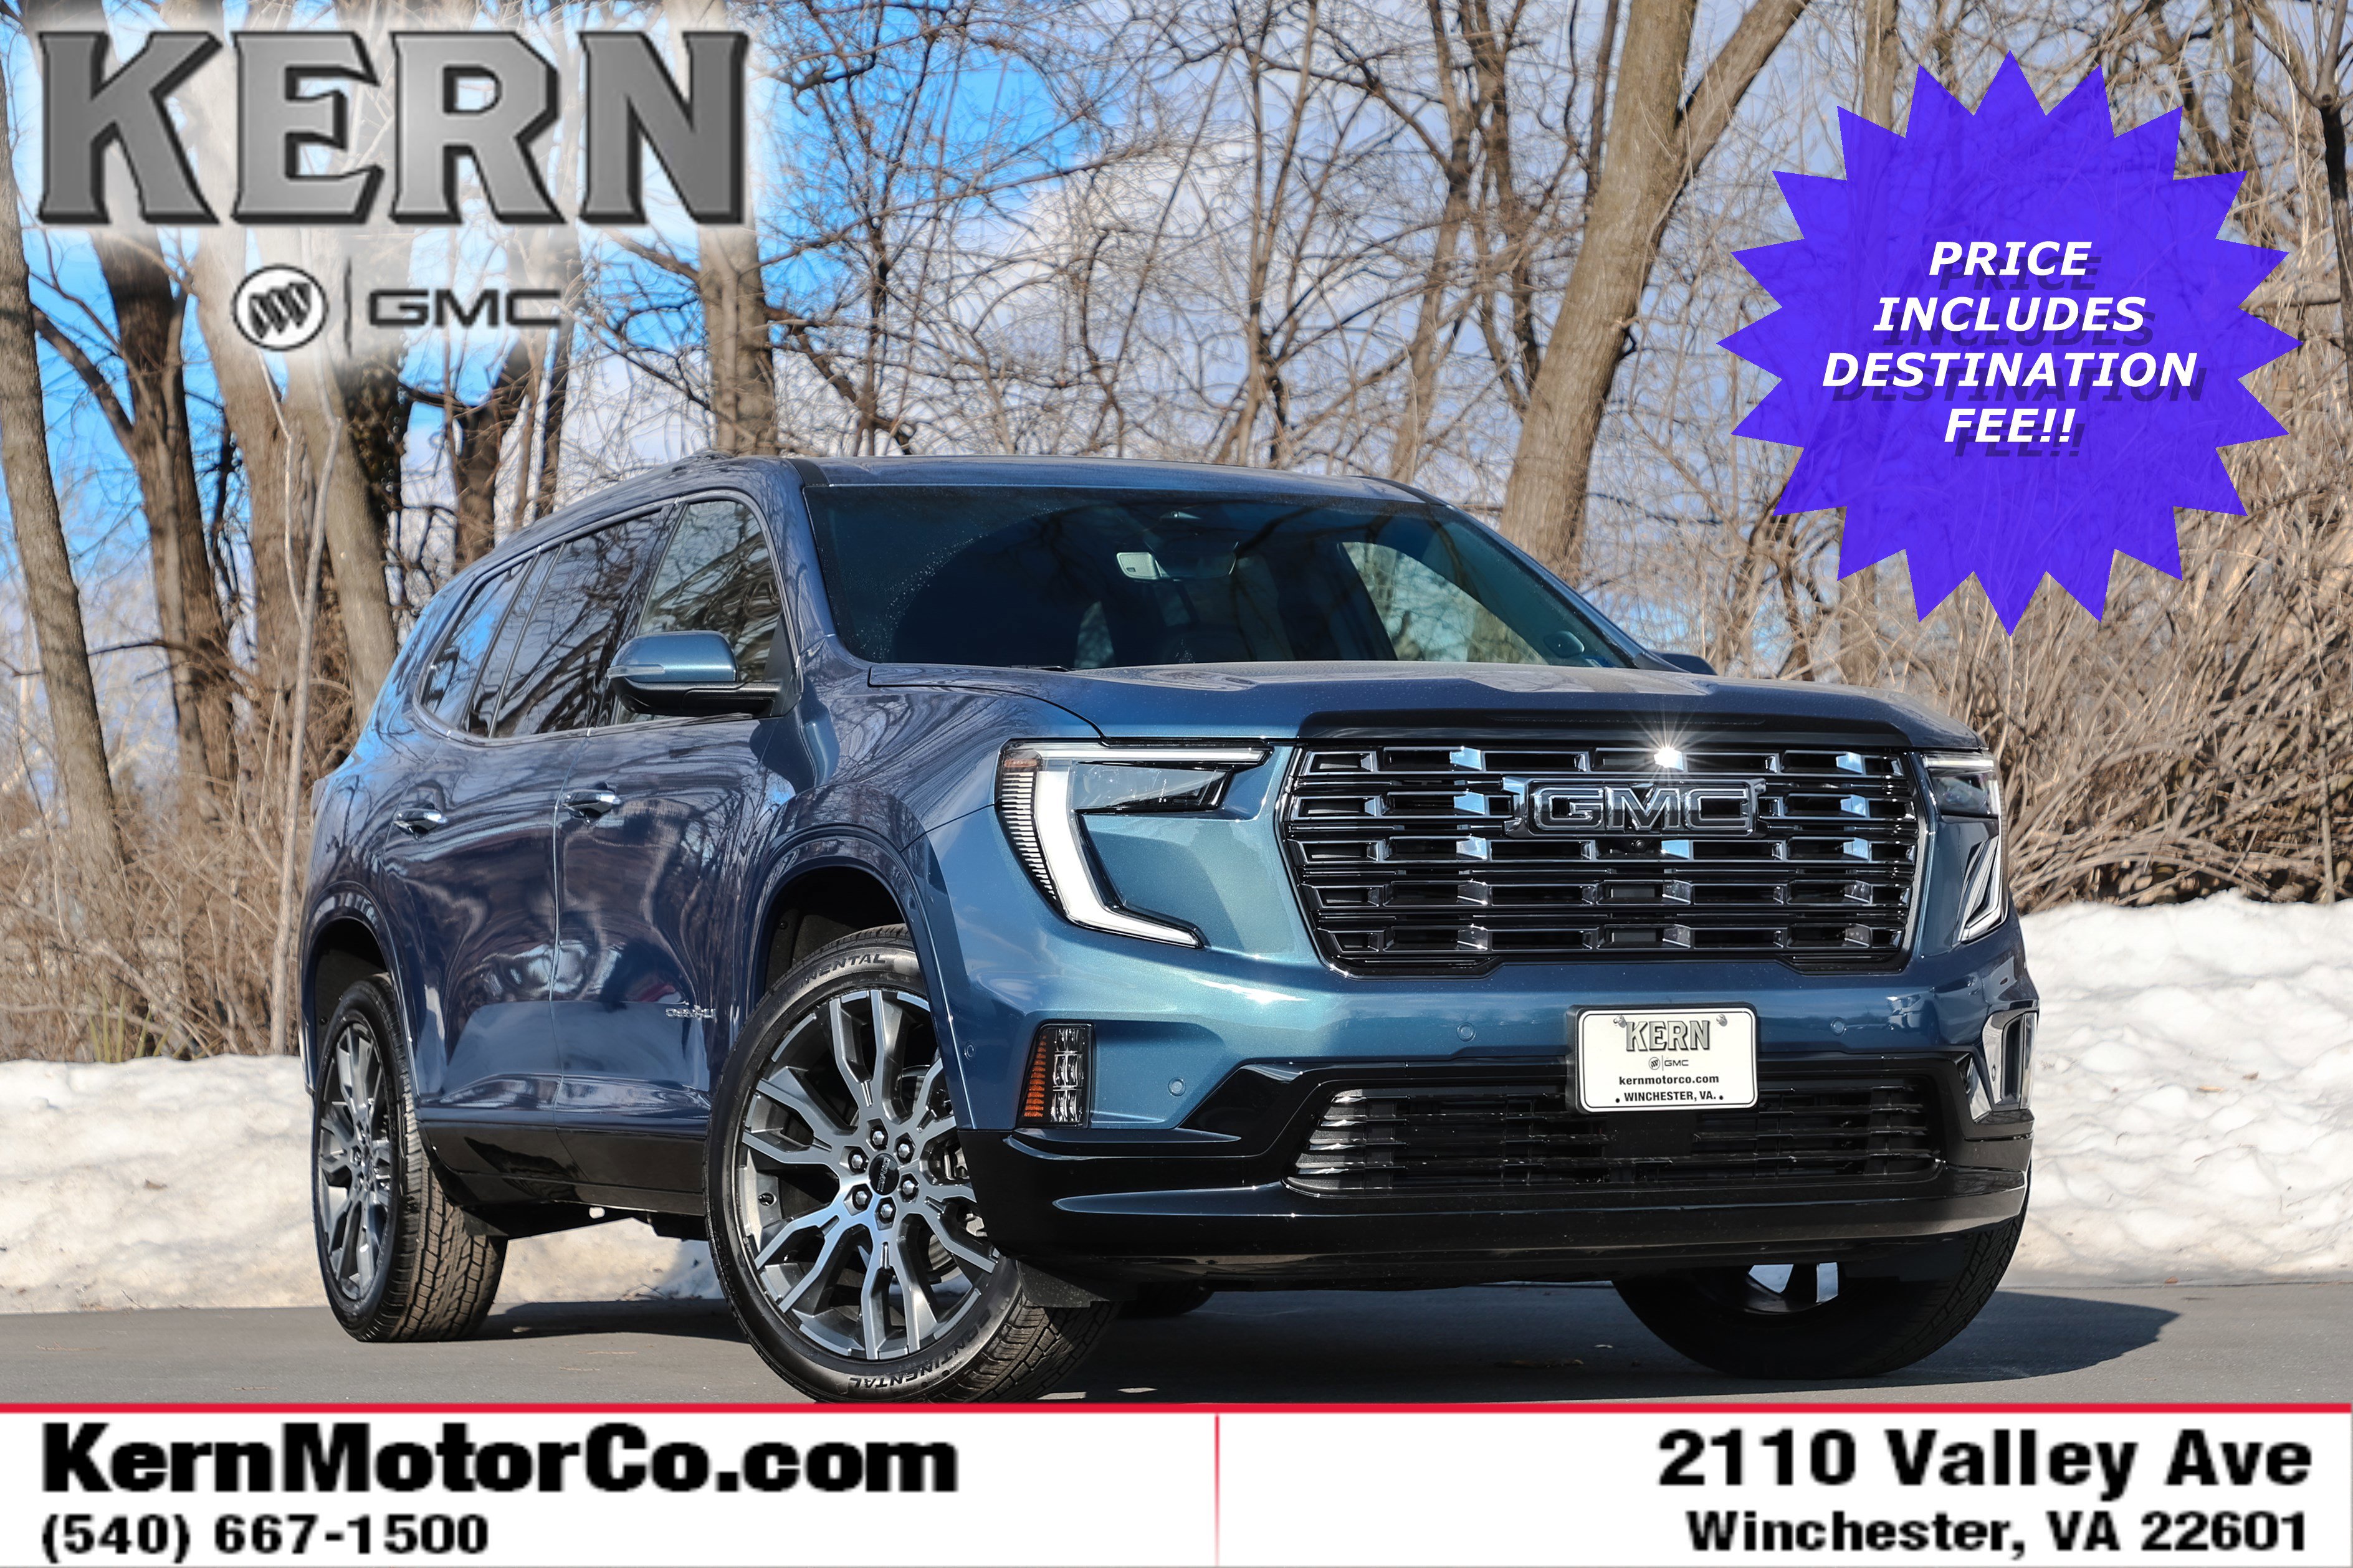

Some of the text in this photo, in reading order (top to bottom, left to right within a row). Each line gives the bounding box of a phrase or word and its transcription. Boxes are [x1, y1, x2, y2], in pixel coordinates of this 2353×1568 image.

[1532, 786, 1750, 832] GMC
[1626, 1020, 1710, 1052] KERN
[1619, 1076, 1719, 1085] kernmotorco.com
[1624, 1091, 1717, 1101] WINCHESTER, VA.
